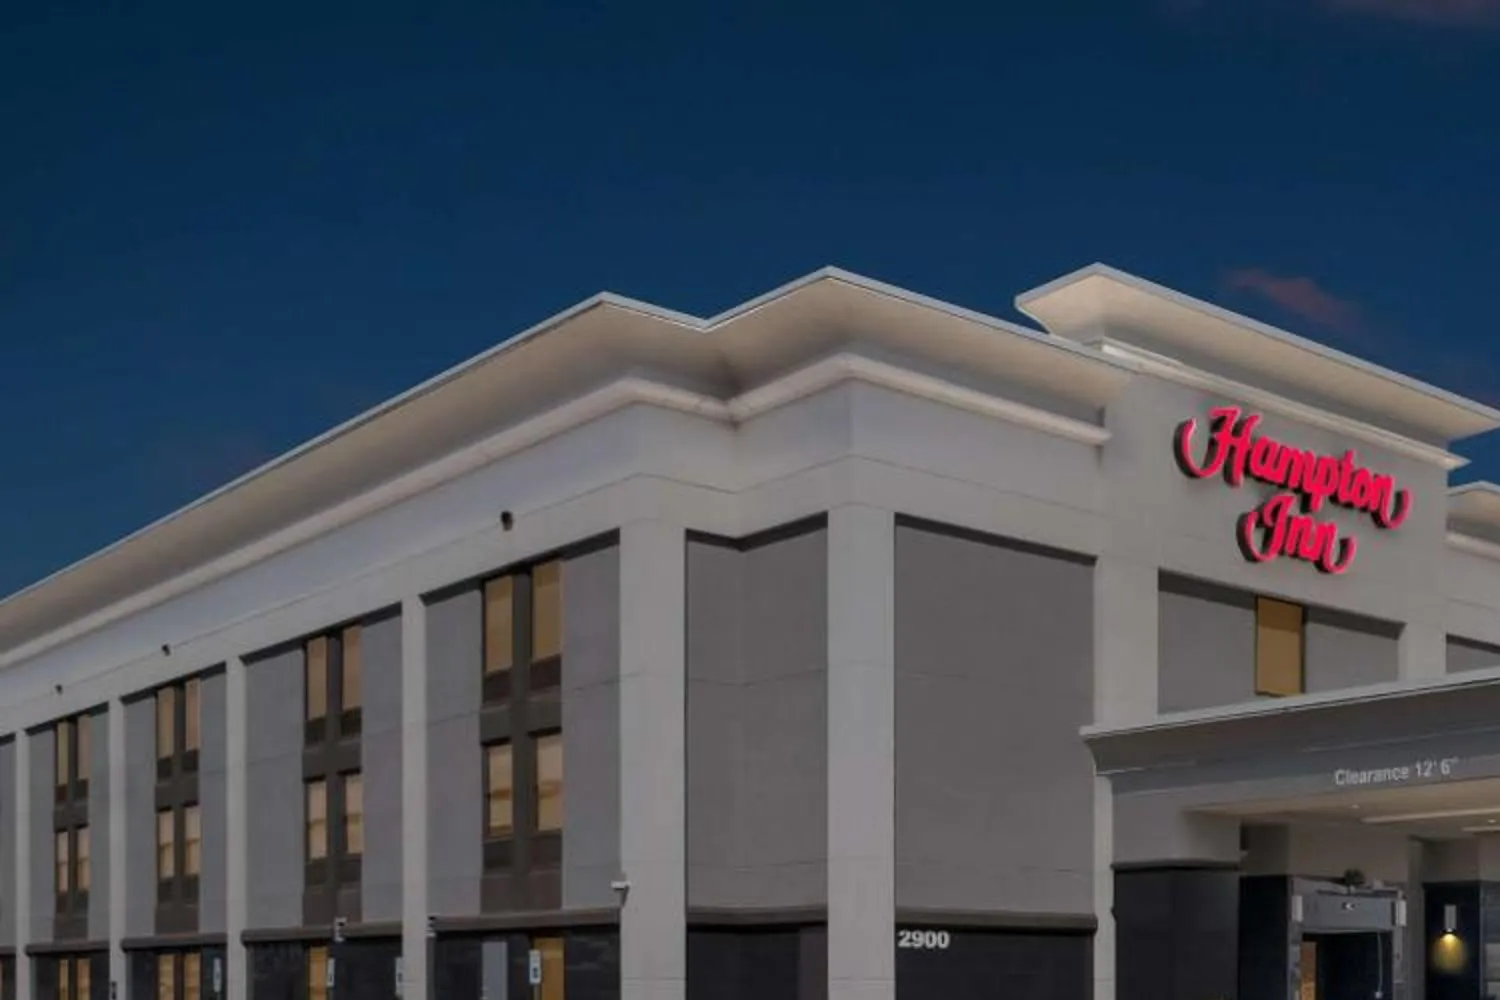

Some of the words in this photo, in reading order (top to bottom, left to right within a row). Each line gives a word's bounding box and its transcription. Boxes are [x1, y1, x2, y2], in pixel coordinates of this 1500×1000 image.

[1177, 405, 1412, 529] Hampton
[1240, 491, 1358, 573] Inn
[1334, 766, 1409, 786] Clearance
[898, 929, 950, 949] 2900
